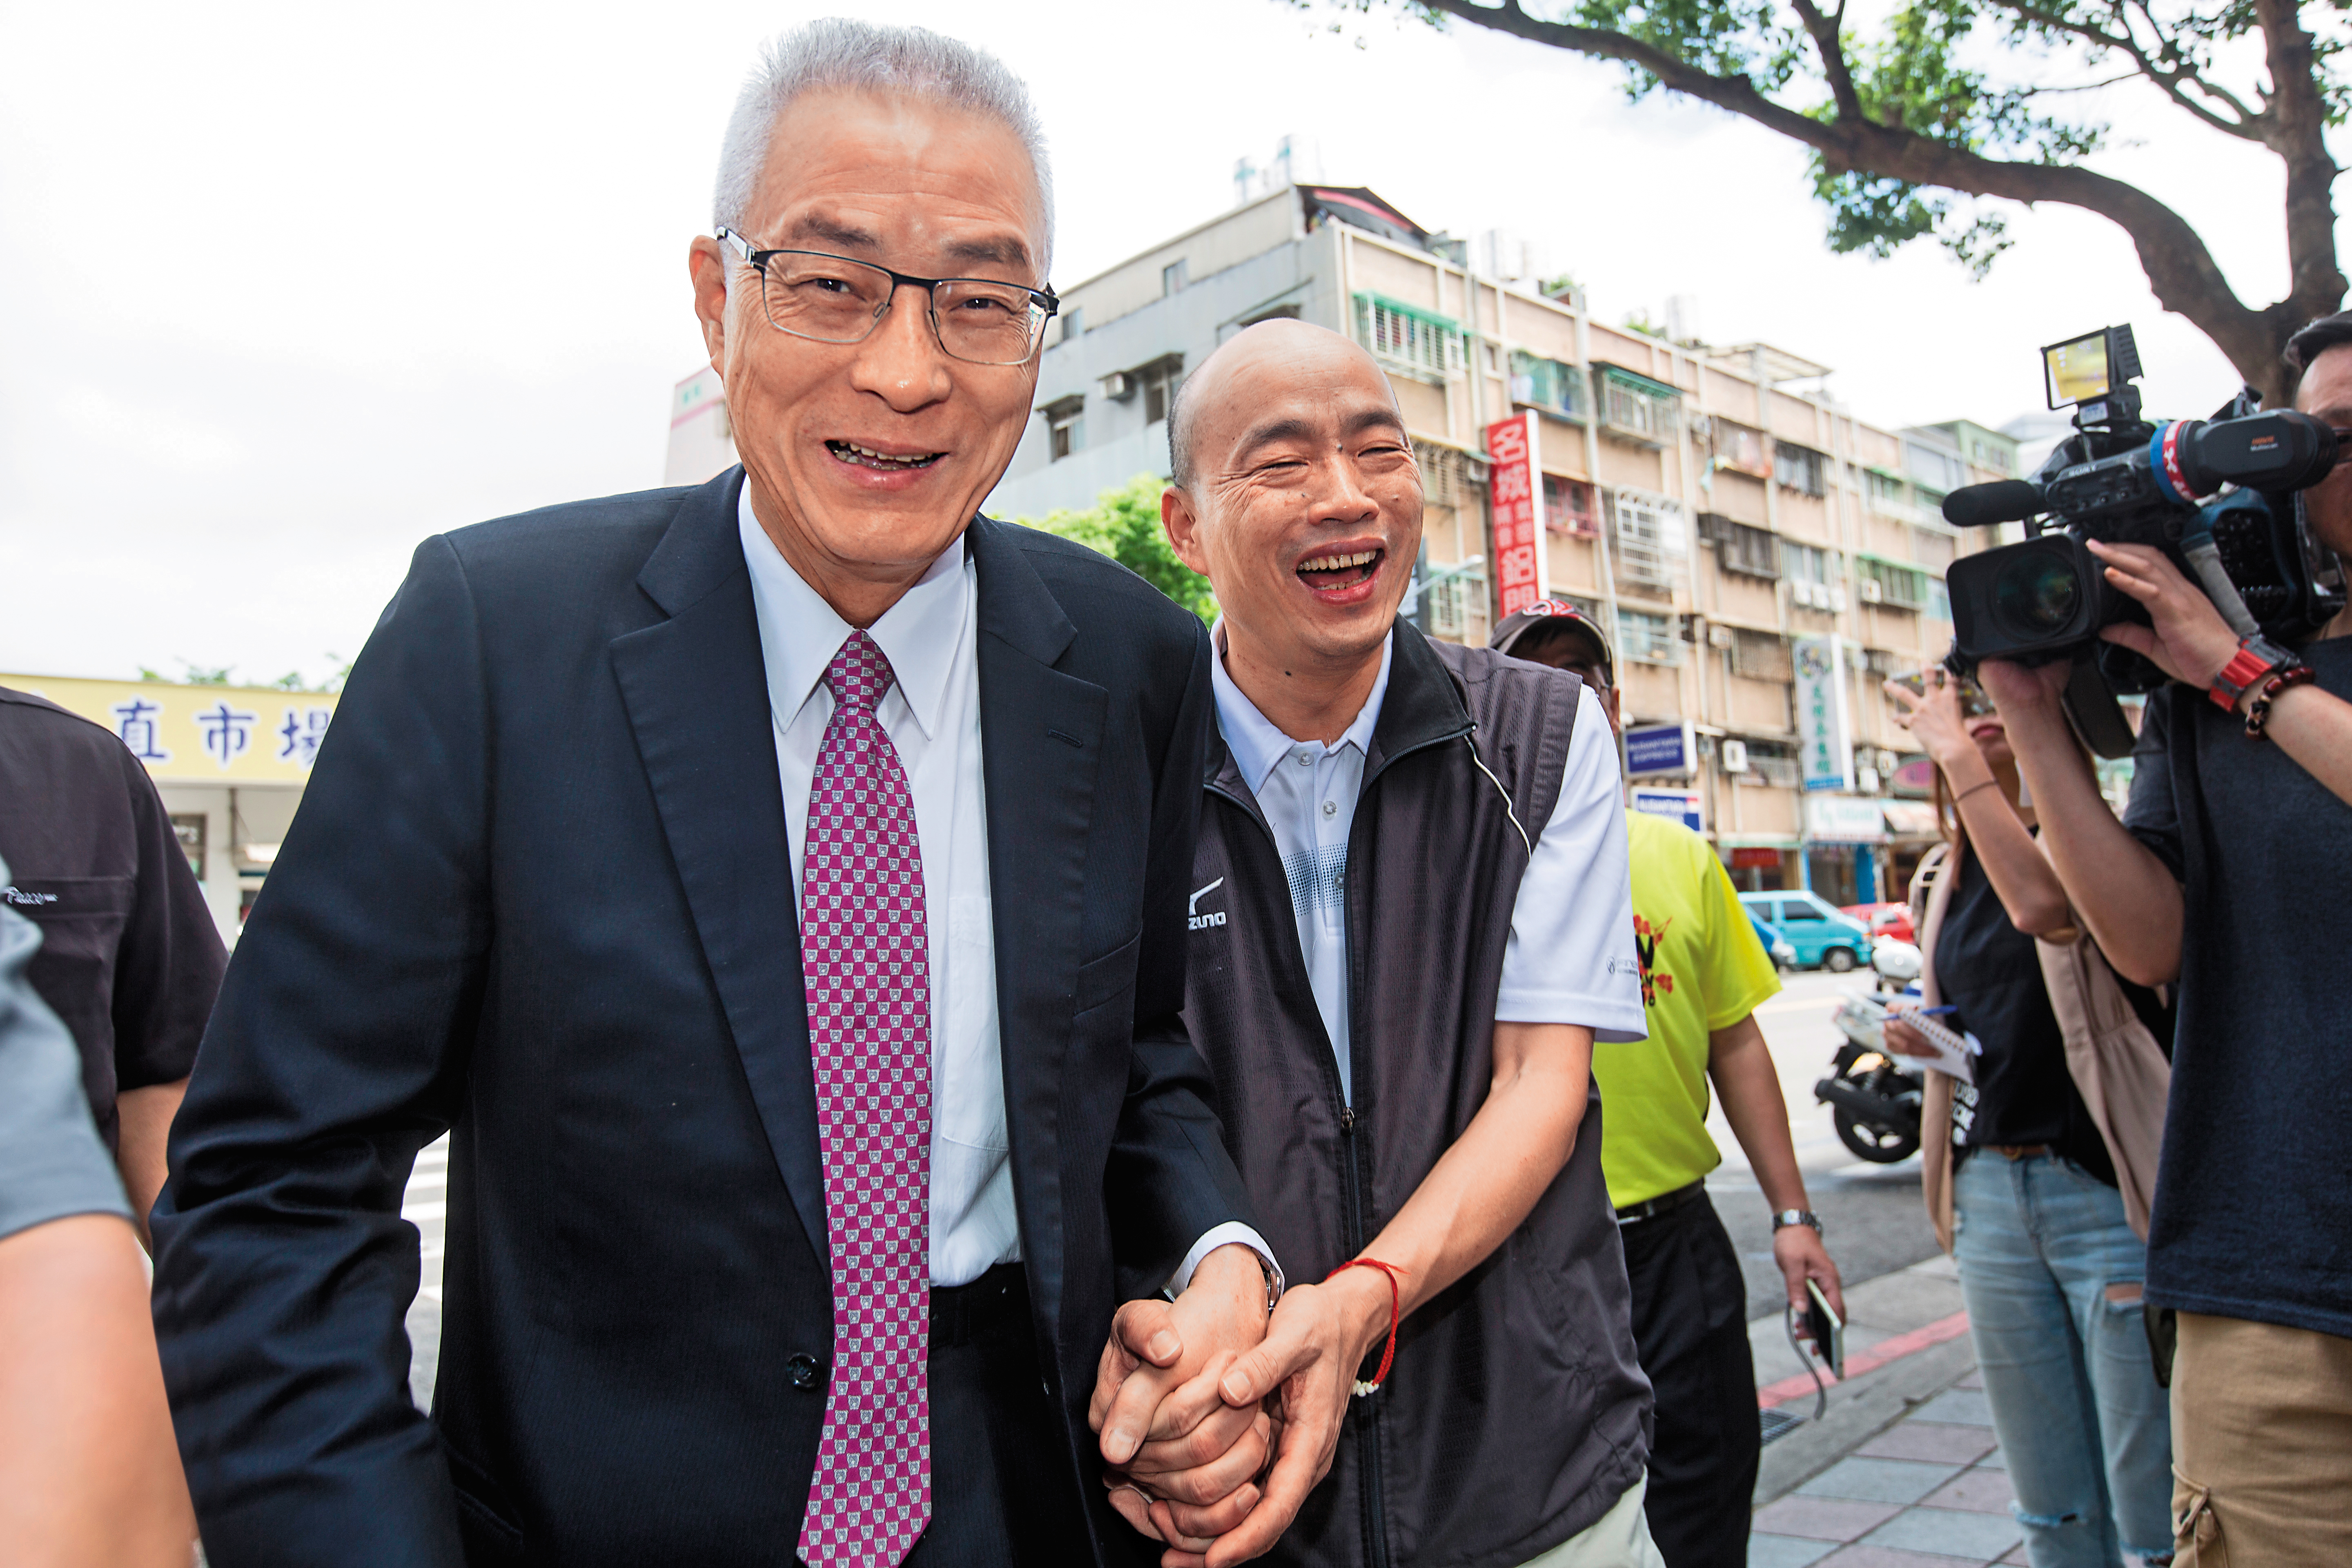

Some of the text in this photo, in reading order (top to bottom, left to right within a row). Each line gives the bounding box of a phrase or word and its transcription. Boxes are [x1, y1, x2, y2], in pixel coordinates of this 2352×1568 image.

[2068, 465, 2096, 477] SONY
[117, 702, 328, 764] 直市場
